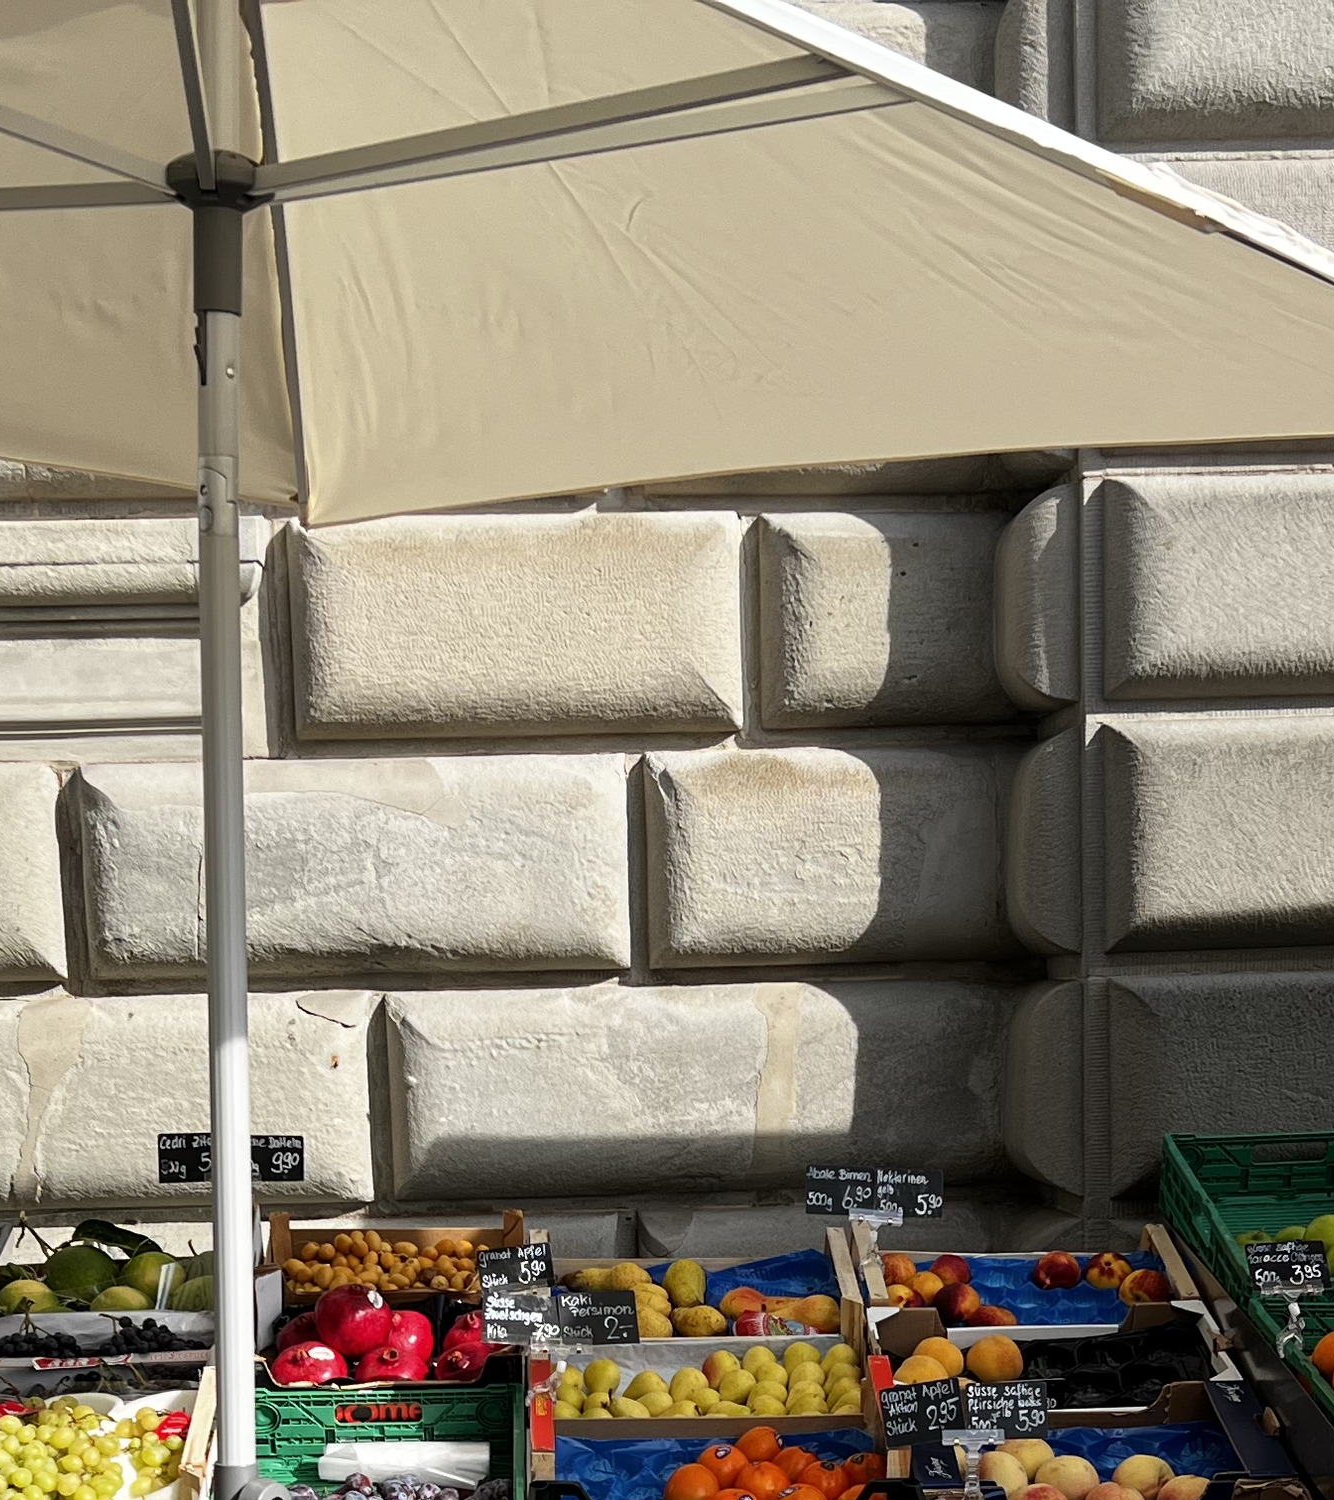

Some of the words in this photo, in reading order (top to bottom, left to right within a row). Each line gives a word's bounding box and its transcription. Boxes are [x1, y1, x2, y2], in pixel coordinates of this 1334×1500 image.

[271, 1152, 300, 1173] 9.90
[806, 1191, 833, 1212] 500g
[841, 1185, 872, 1209] 6.90
[914, 1193, 943, 1215] 5.90
[517, 1244, 546, 1260] Apfel
[517, 1259, 546, 1285] 5.90
[561, 1293, 593, 1307] Kaki
[568, 1302, 635, 1318] Persimon
[485, 1323, 508, 1339] Kilo
[922, 1379, 955, 1399] Apfel
[966, 1383, 999, 1398] süsse
[886, 1417, 919, 1437] Stück
[926, 1396, 960, 1431] 2.95
[1015, 1409, 1046, 1433] 5.90
